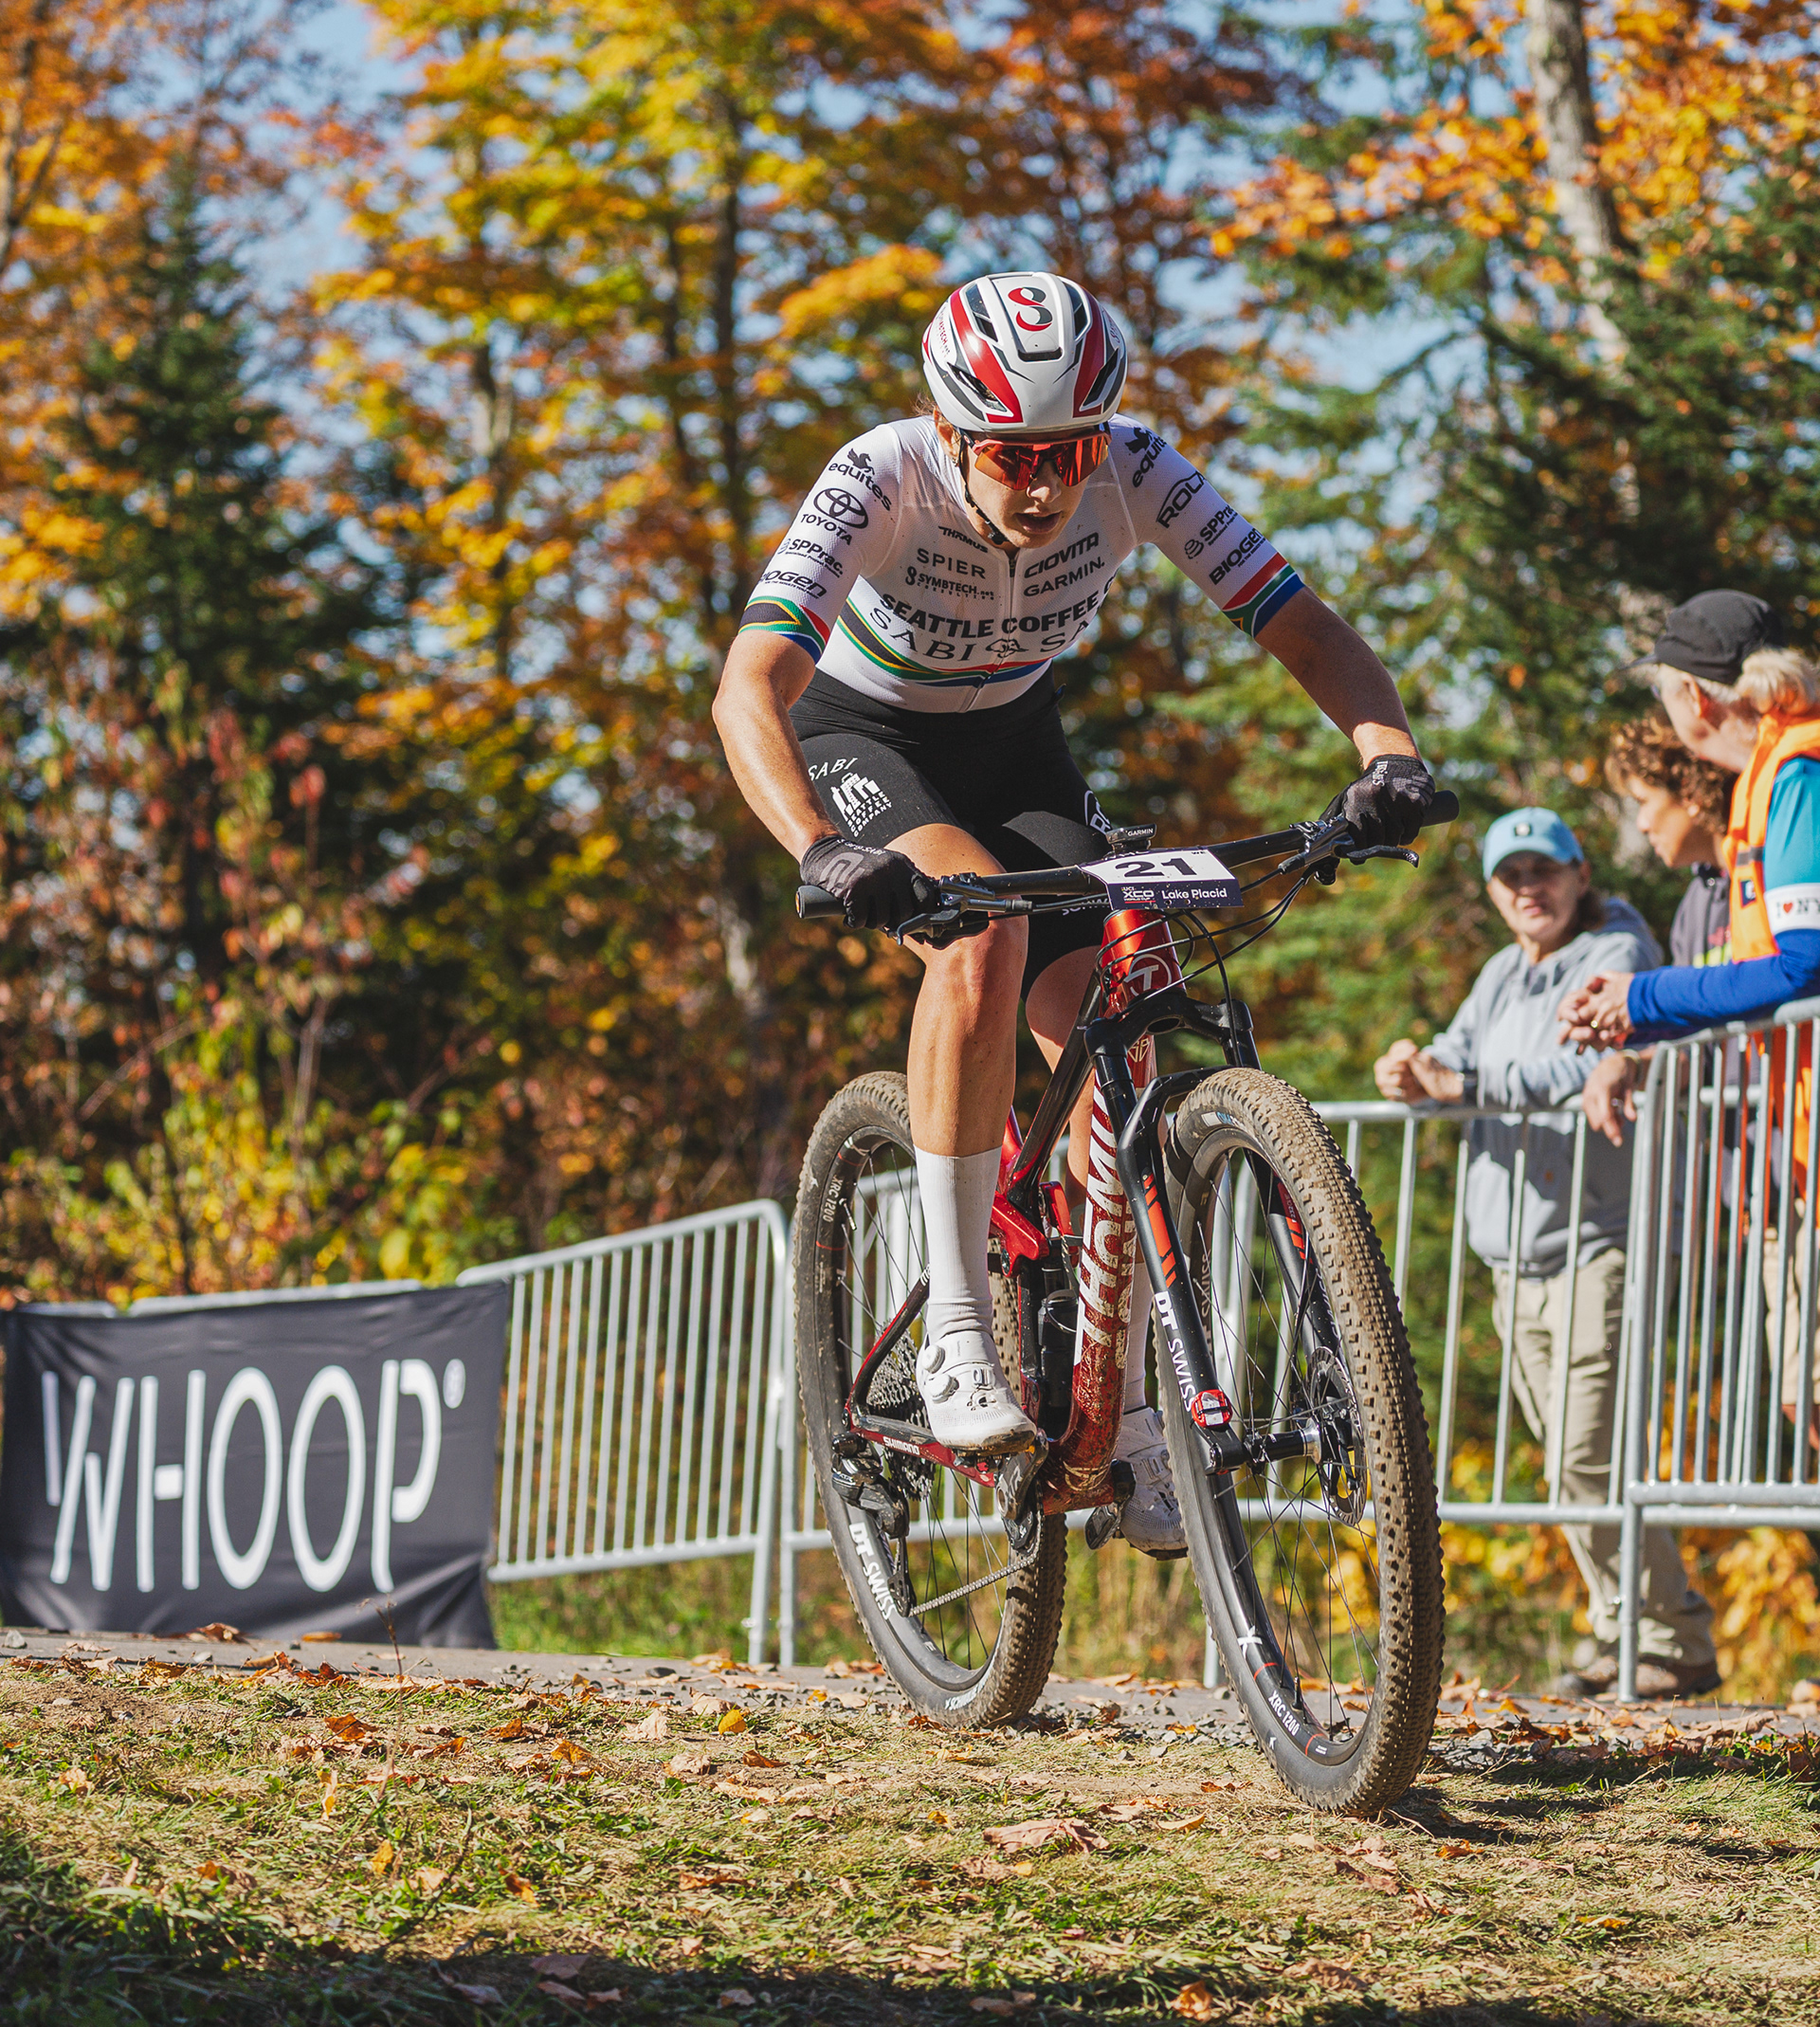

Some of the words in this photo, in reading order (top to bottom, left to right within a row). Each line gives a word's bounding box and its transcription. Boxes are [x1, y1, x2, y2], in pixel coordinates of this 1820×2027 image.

[828, 462, 892, 511] equites
[801, 513, 853, 545] TOYOTA
[917, 548, 986, 579] SPIER
[1025, 532, 1099, 578] CIOVITA
[880, 593, 994, 638] SEATTLE
[1002, 591, 1099, 634] COFFEE
[870, 607, 976, 661] SABI
[808, 758, 858, 781] SABI
[854, 802, 892, 837] COMPANY
[1115, 857, 1197, 877] 21
[1123, 889, 1155, 899] XCO
[1161, 889, 1189, 900] Lake
[1191, 887, 1228, 899] Placid
[828, 1175, 844, 1198] XRC
[823, 1197, 837, 1222] 1200
[1155, 1291, 1178, 1331] DT
[1167, 1338, 1197, 1412] SWISS
[882, 1435, 920, 1455] SHIMANO
[42, 1359, 443, 1593] WHOOP
[849, 1522, 874, 1556] DT
[864, 1562, 898, 1619] SWISS
[1268, 1689, 1286, 1717] XRC
[1282, 1710, 1301, 1736] 1200
